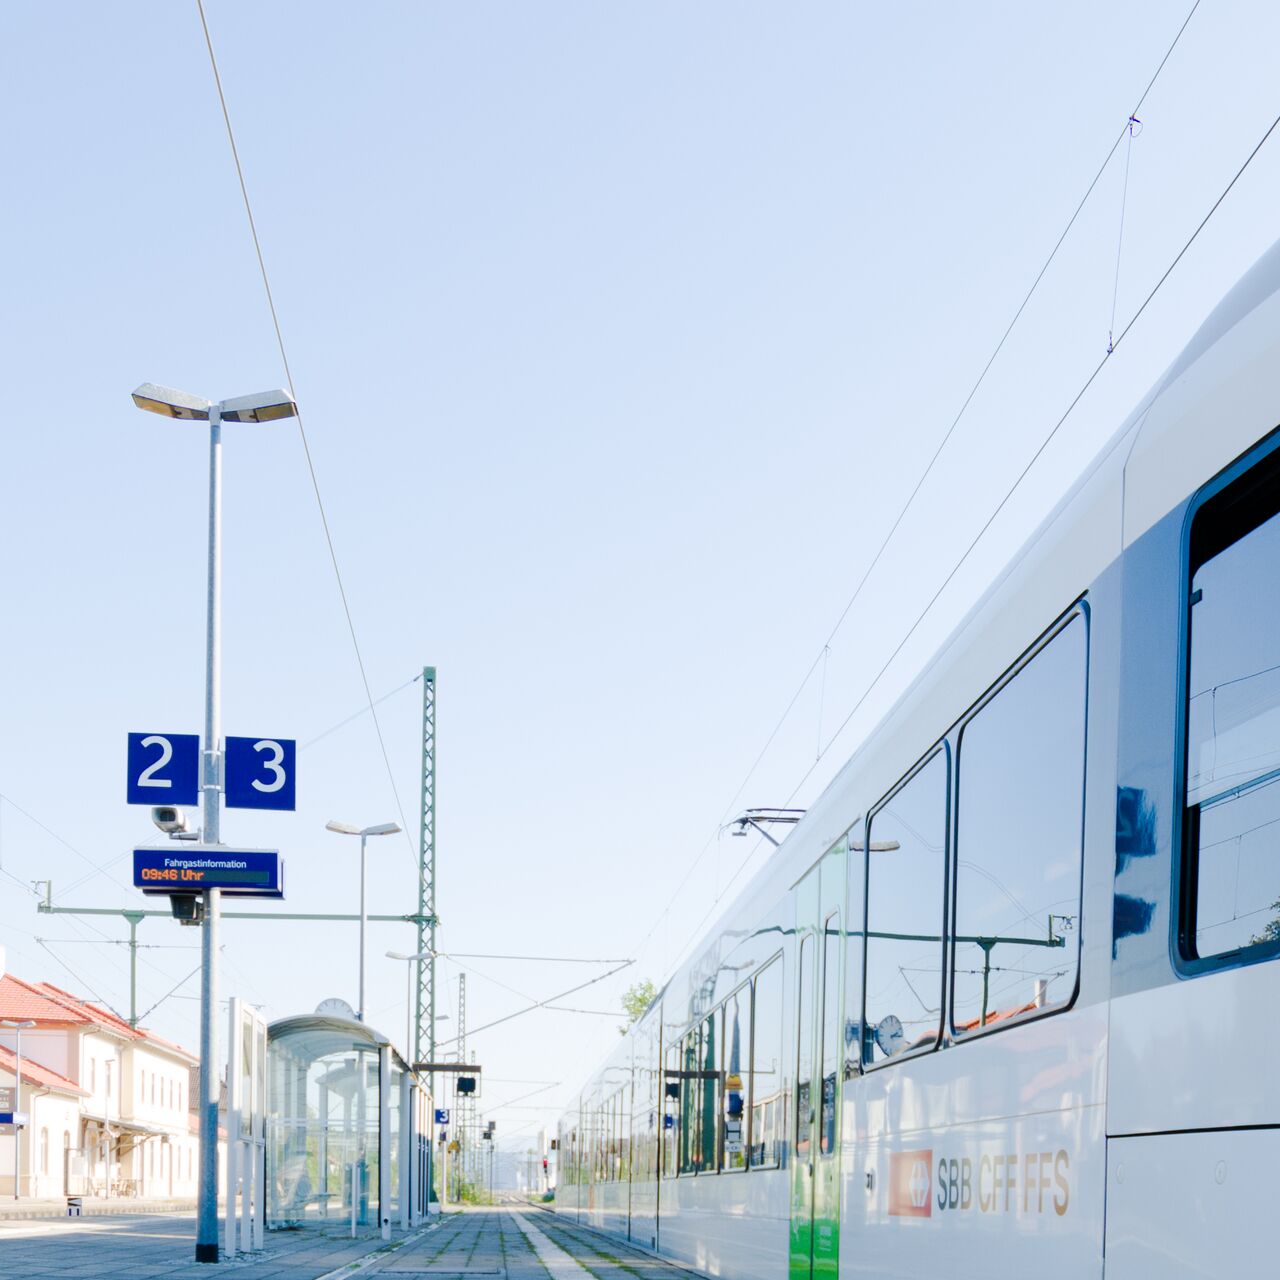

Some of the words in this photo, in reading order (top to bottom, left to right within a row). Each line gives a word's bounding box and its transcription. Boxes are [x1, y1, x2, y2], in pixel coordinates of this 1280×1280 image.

[137, 735, 173, 788] 2
[251, 740, 286, 793] 3
[141, 868, 178, 880] 09:46
[181, 869, 205, 881] Uhr
[164, 858, 247, 869] Fahrgastinformation
[439, 1109, 449, 1122] 3
[937, 1157, 972, 1211] SBB
[978, 1153, 1018, 1213] CFF
[1024, 1149, 1070, 1216] FFS
